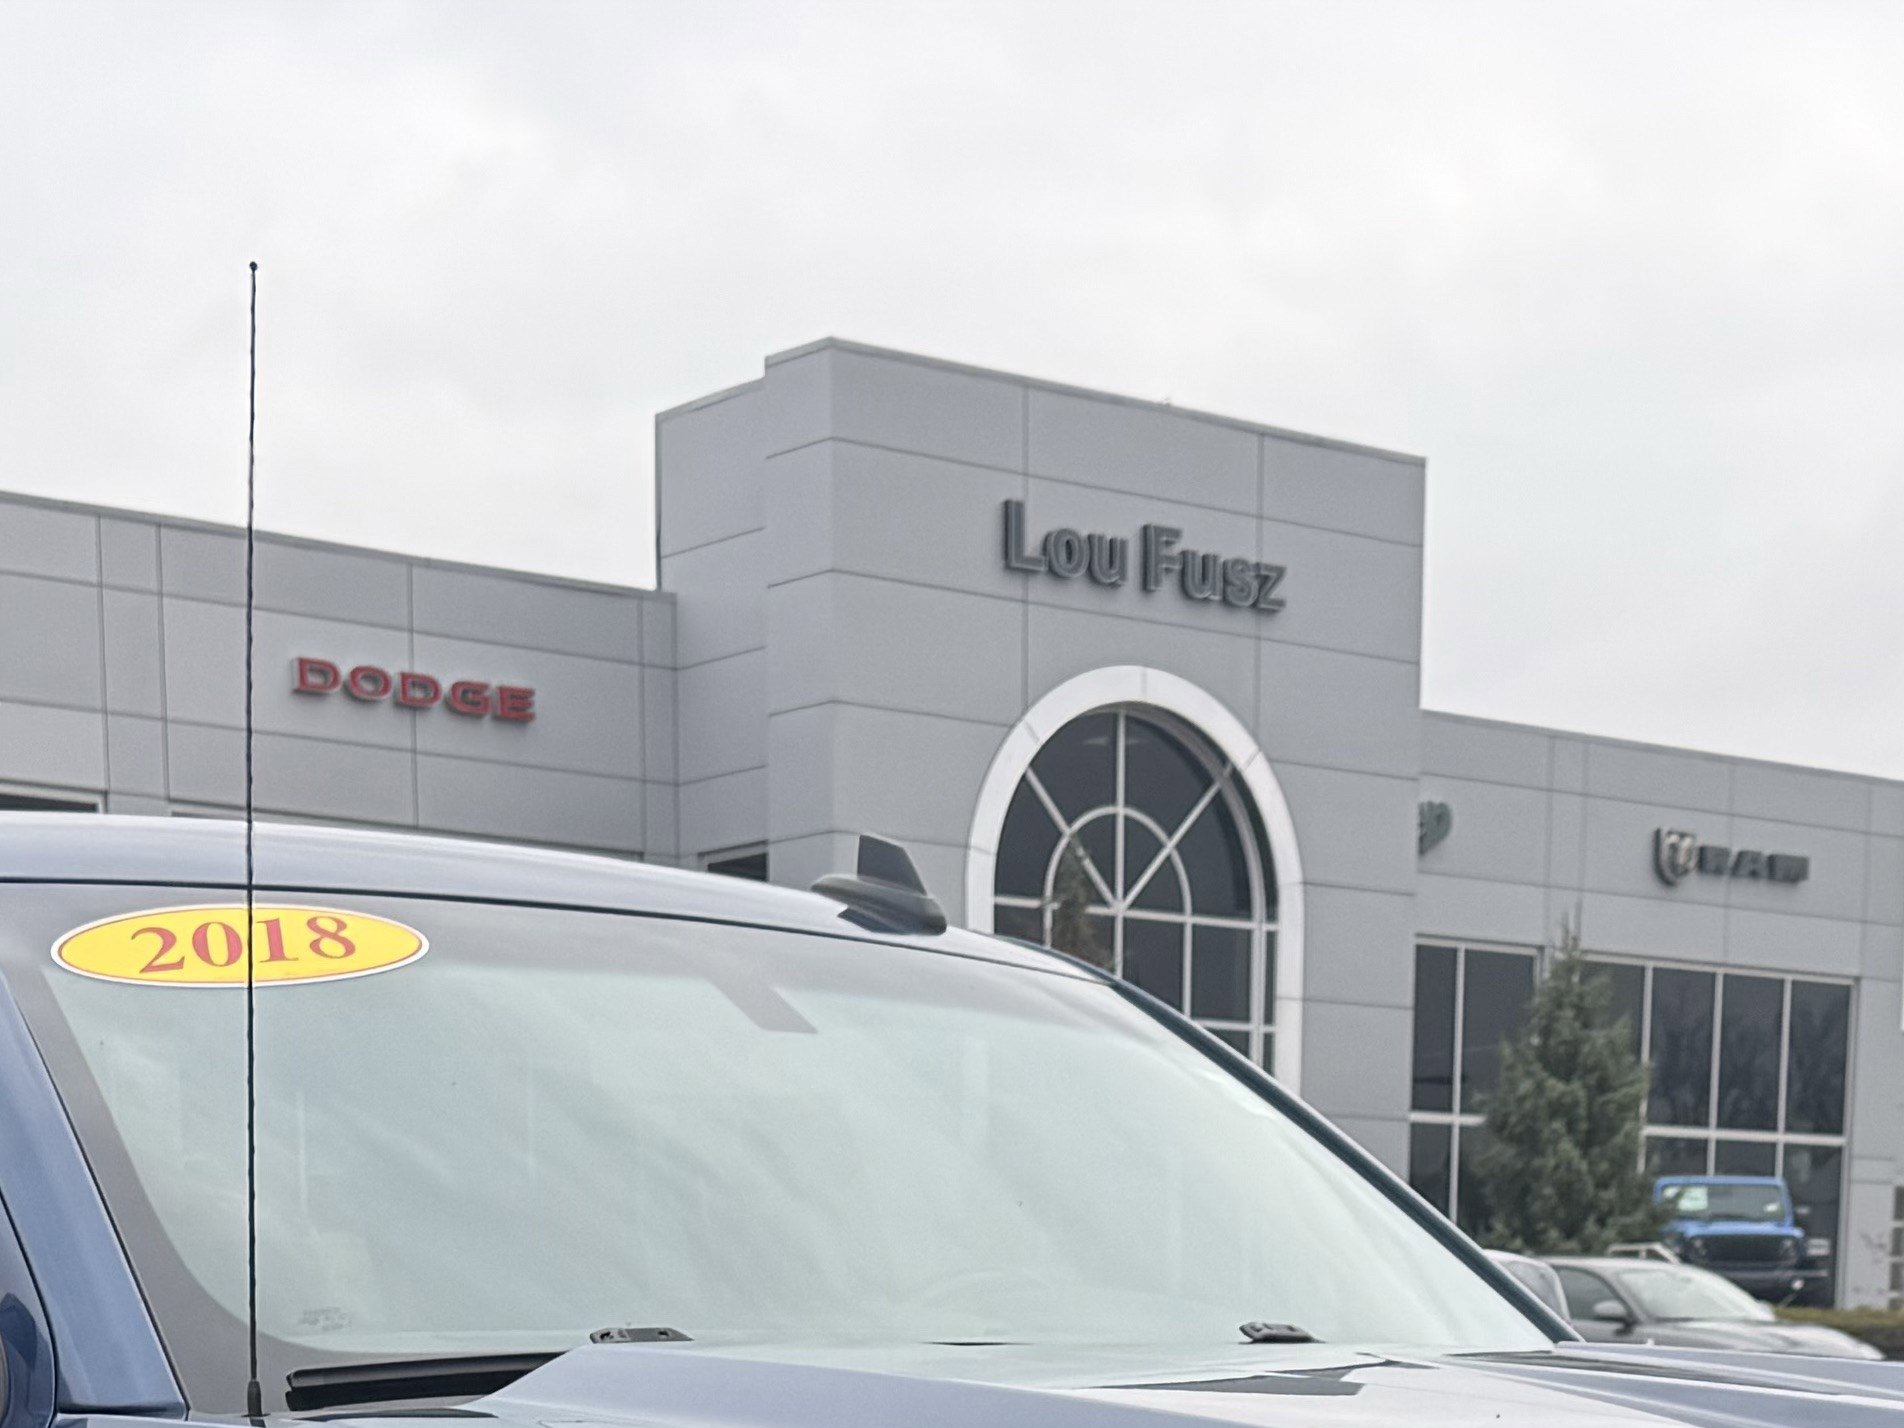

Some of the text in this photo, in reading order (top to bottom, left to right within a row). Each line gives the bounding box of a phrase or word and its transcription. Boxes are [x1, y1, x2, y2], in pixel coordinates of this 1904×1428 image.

[1002, 499, 1288, 615] Lou Fusz
[292, 656, 536, 722] DODGE
[130, 915, 356, 974] 2018
